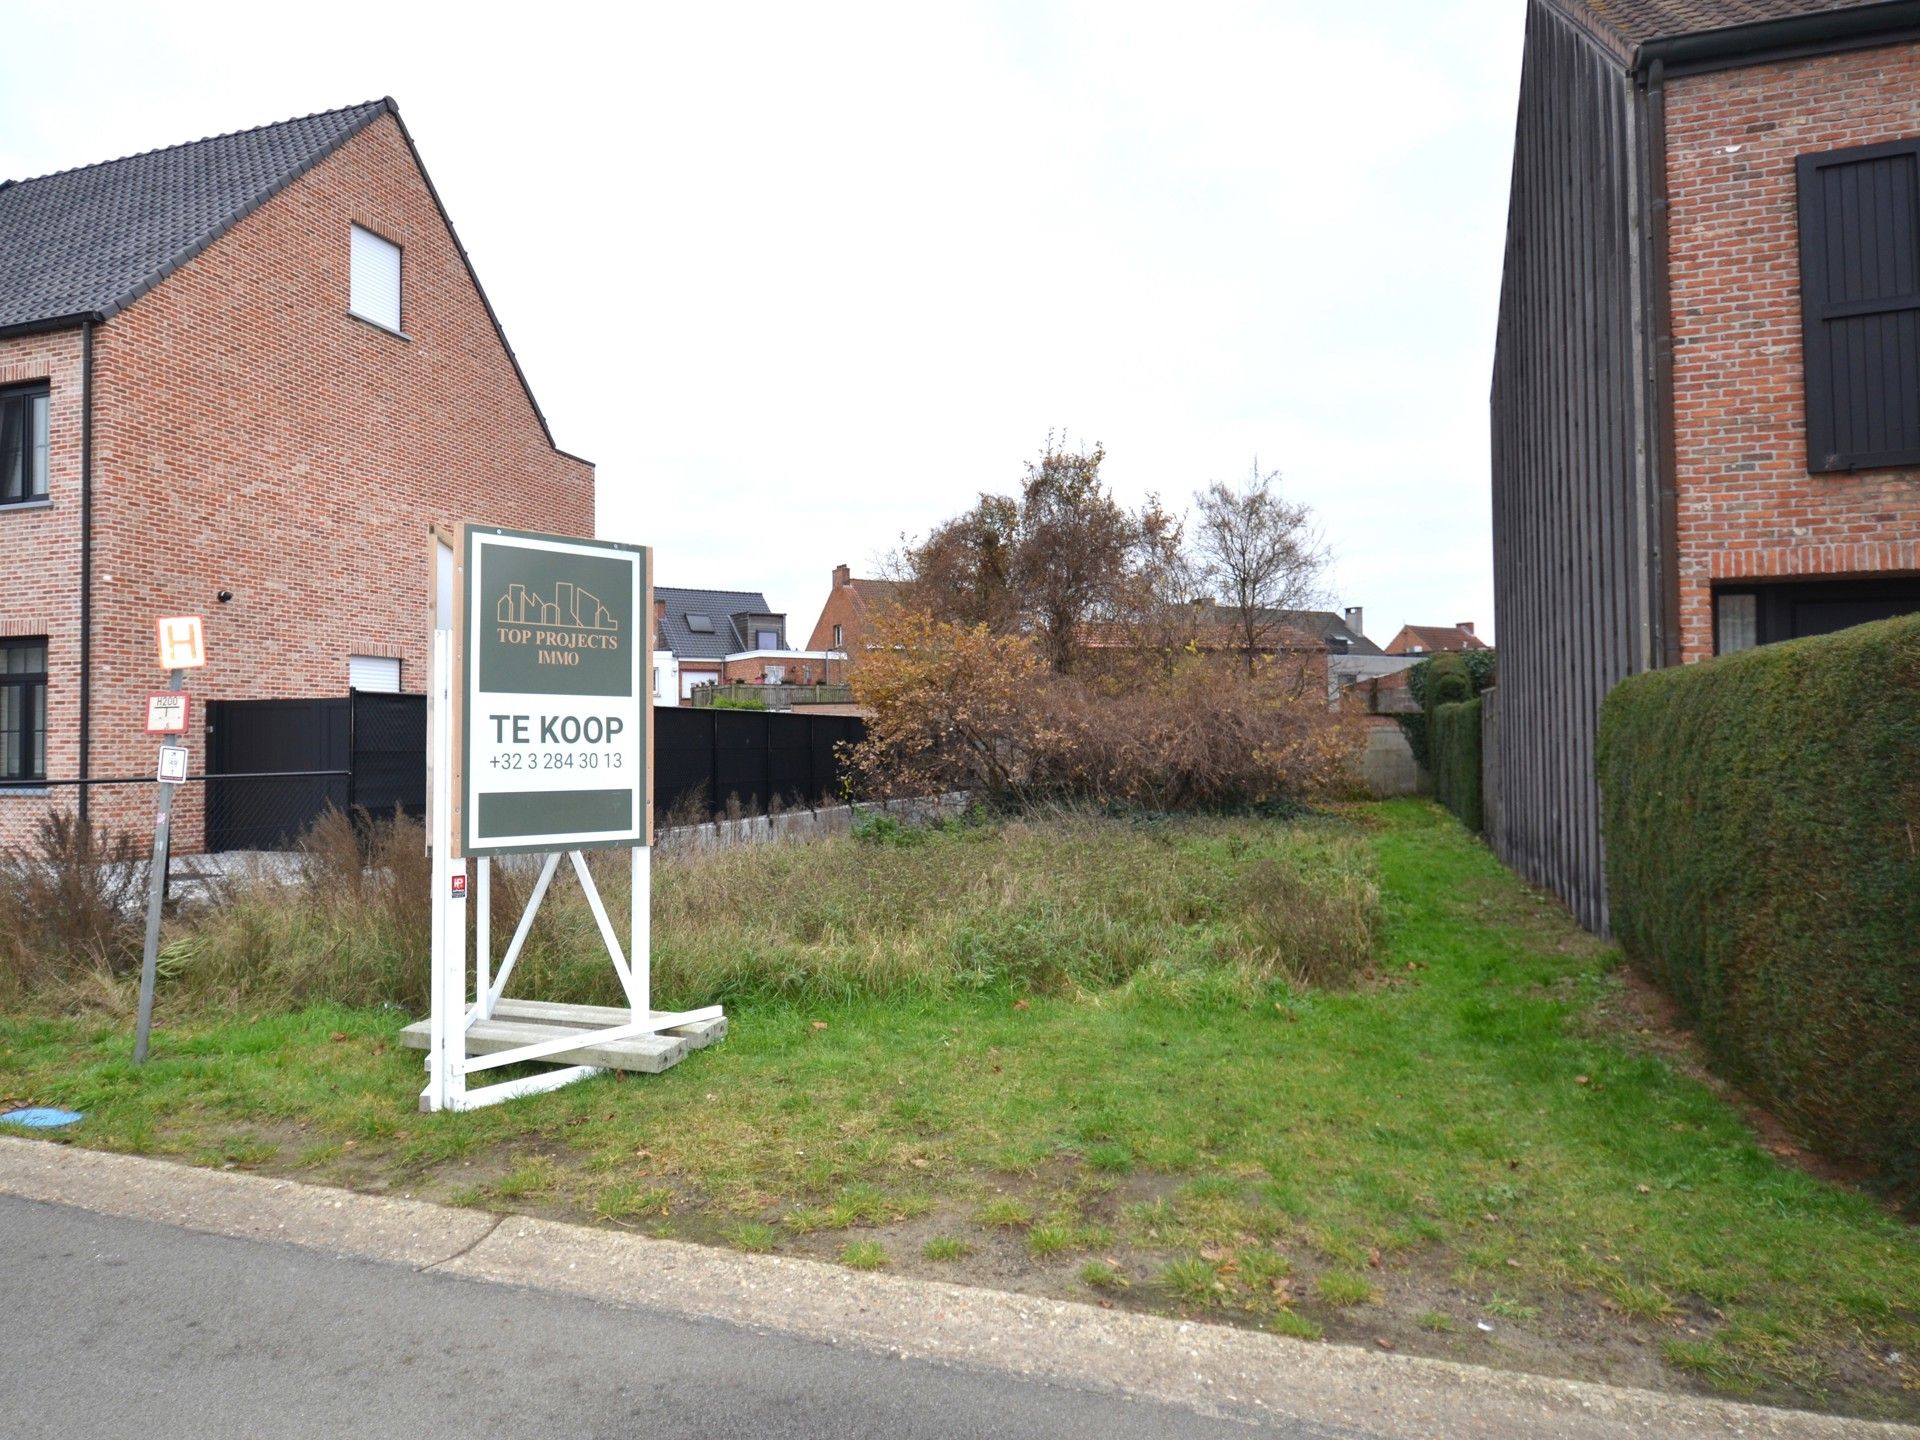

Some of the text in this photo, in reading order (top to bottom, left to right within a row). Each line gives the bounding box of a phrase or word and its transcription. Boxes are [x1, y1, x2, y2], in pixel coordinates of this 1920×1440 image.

[168, 624, 196, 659] H
[497, 627, 617, 649] TOP PROJECTS
[538, 649, 579, 665] IMMO
[489, 715, 623, 744] TE KOOP
[490, 753, 622, 769] +32 3 284 30 13
